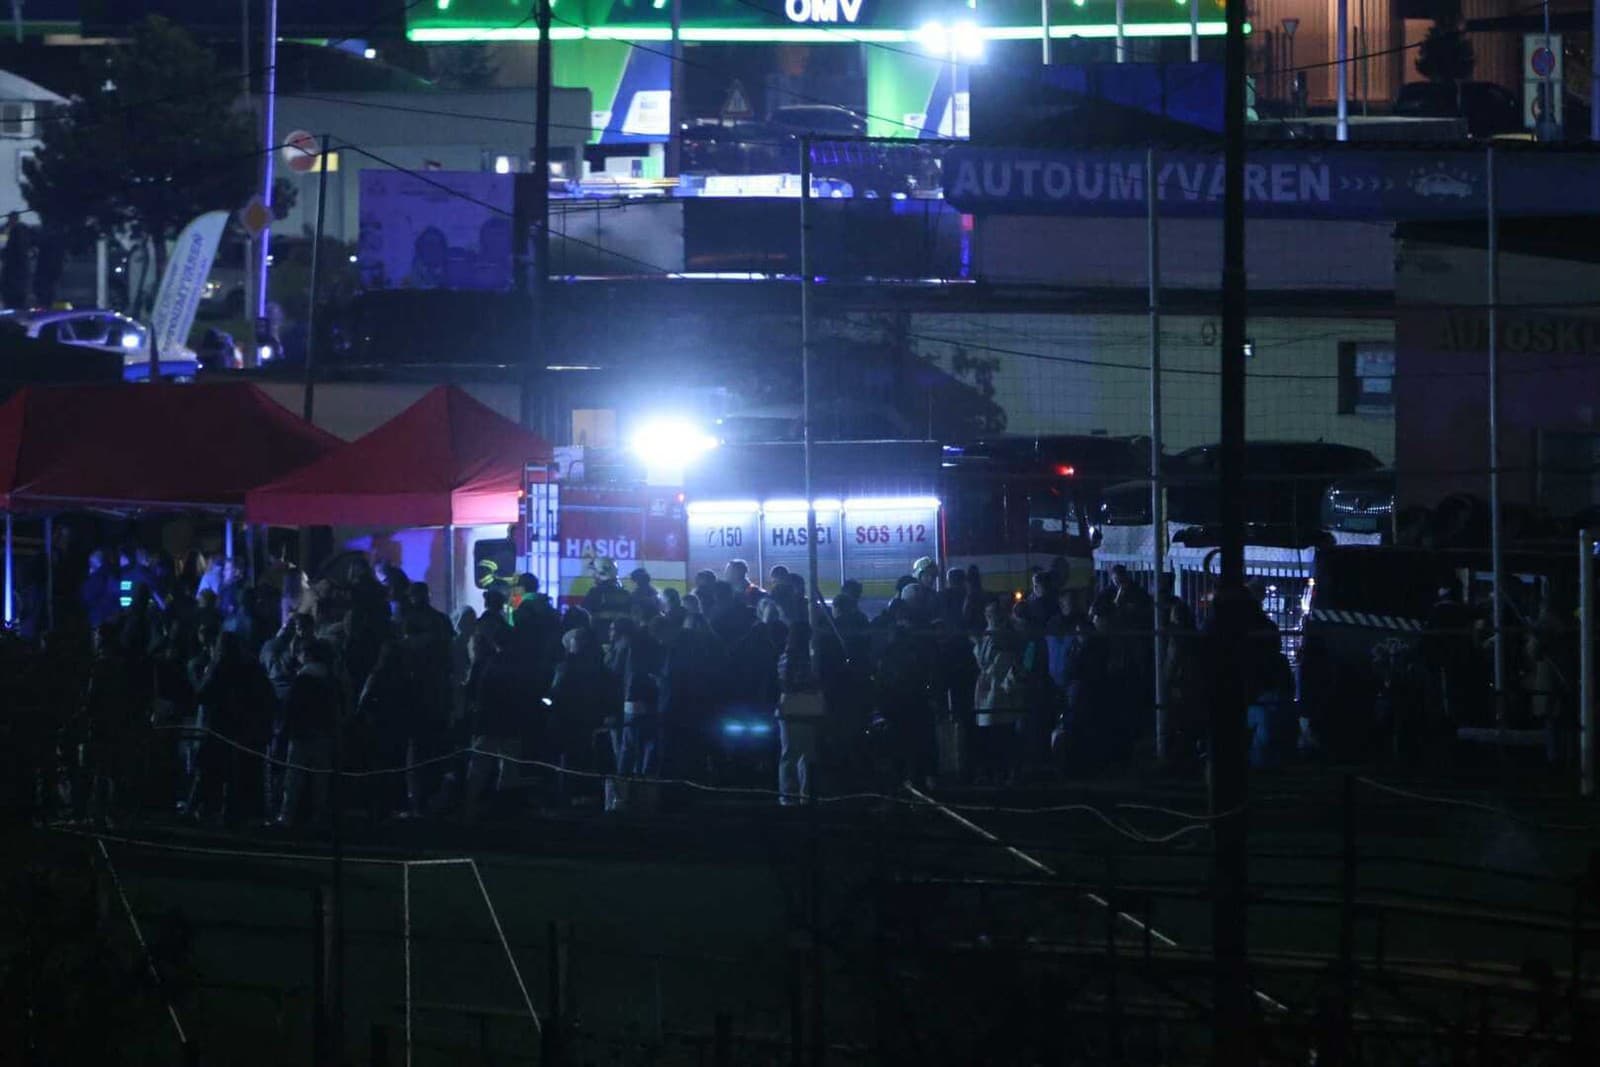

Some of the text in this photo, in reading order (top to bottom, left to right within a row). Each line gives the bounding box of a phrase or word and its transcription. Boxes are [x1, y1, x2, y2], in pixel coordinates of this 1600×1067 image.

[785, 0, 862, 22] OMV
[566, 535, 636, 559] HASIČI
[720, 523, 926, 547] 150 HASČI SOS 112
